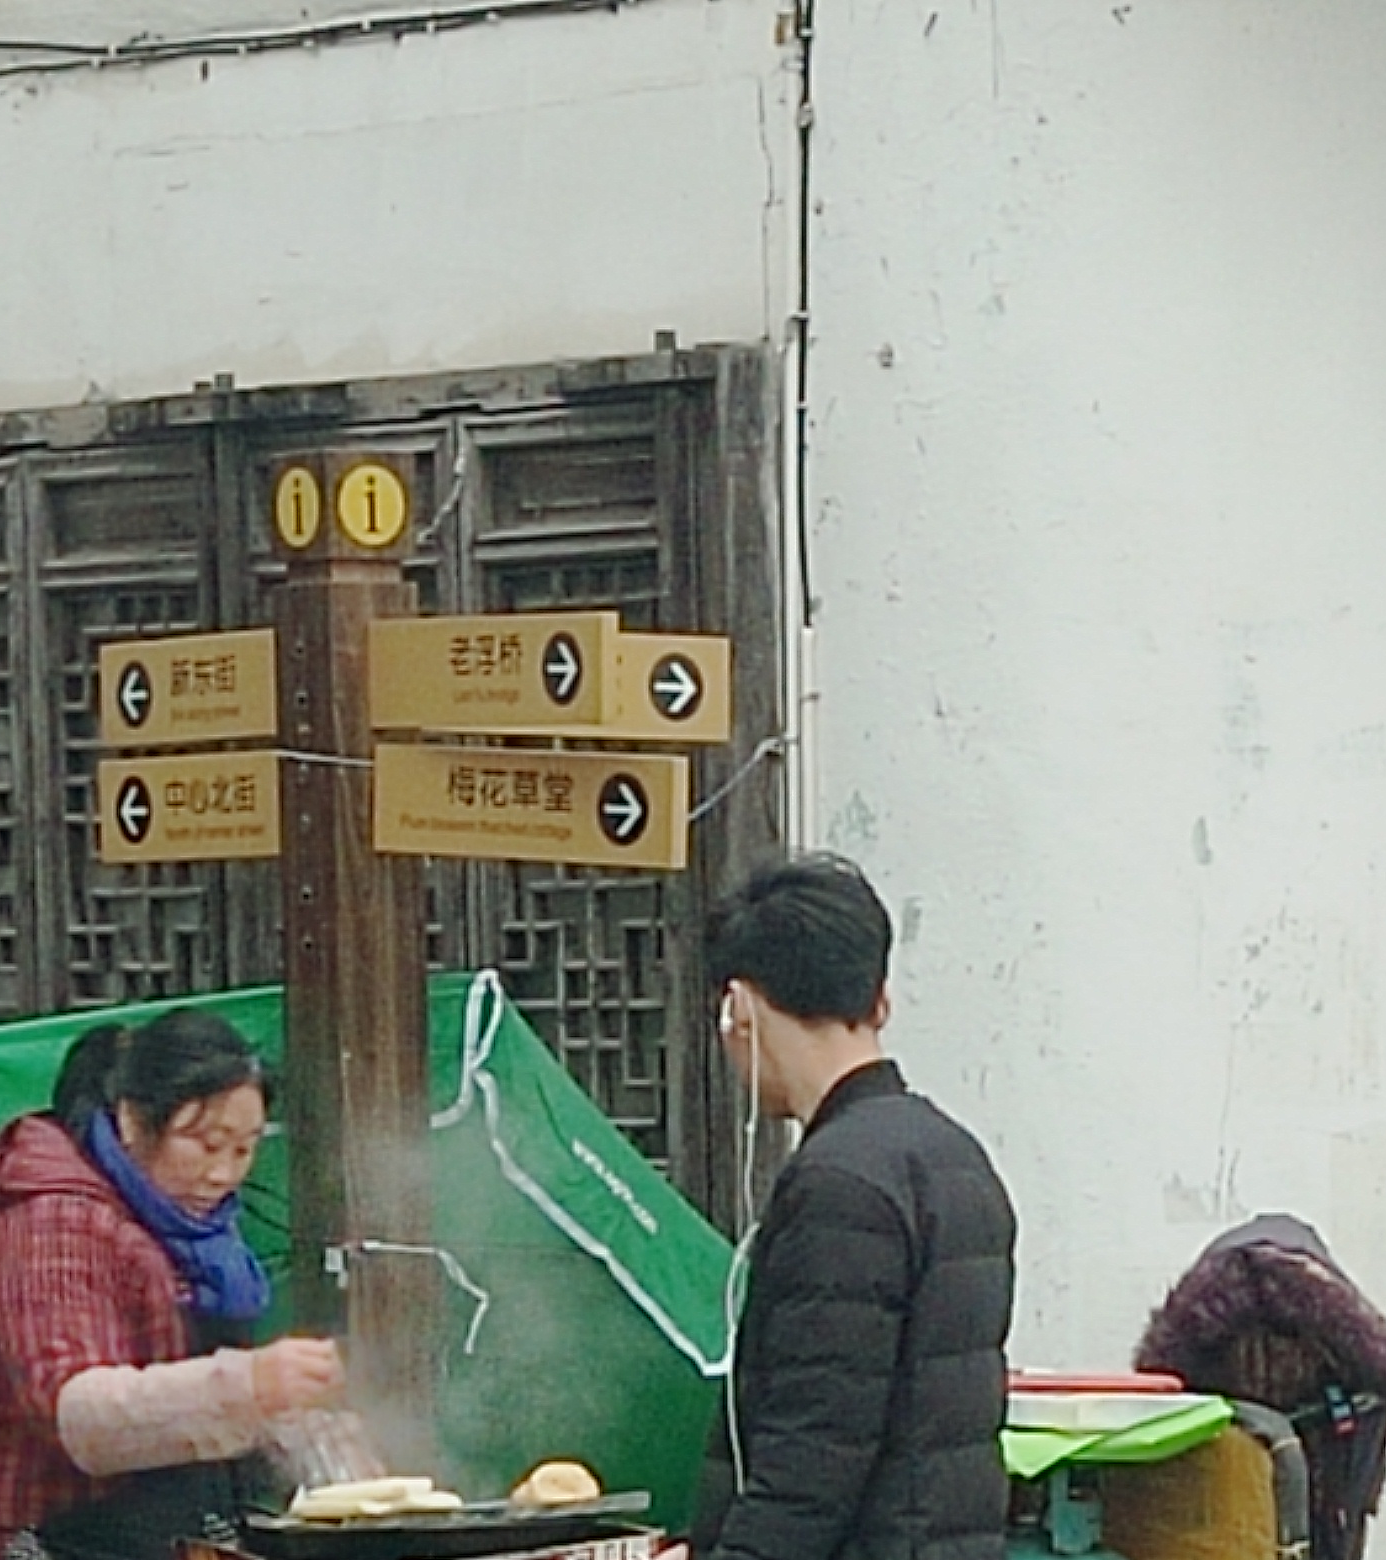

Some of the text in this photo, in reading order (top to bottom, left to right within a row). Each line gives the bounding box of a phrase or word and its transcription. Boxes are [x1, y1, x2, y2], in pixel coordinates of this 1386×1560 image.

[165, 773, 256, 816] 中心北街
[447, 765, 573, 811] 梅花草堂
